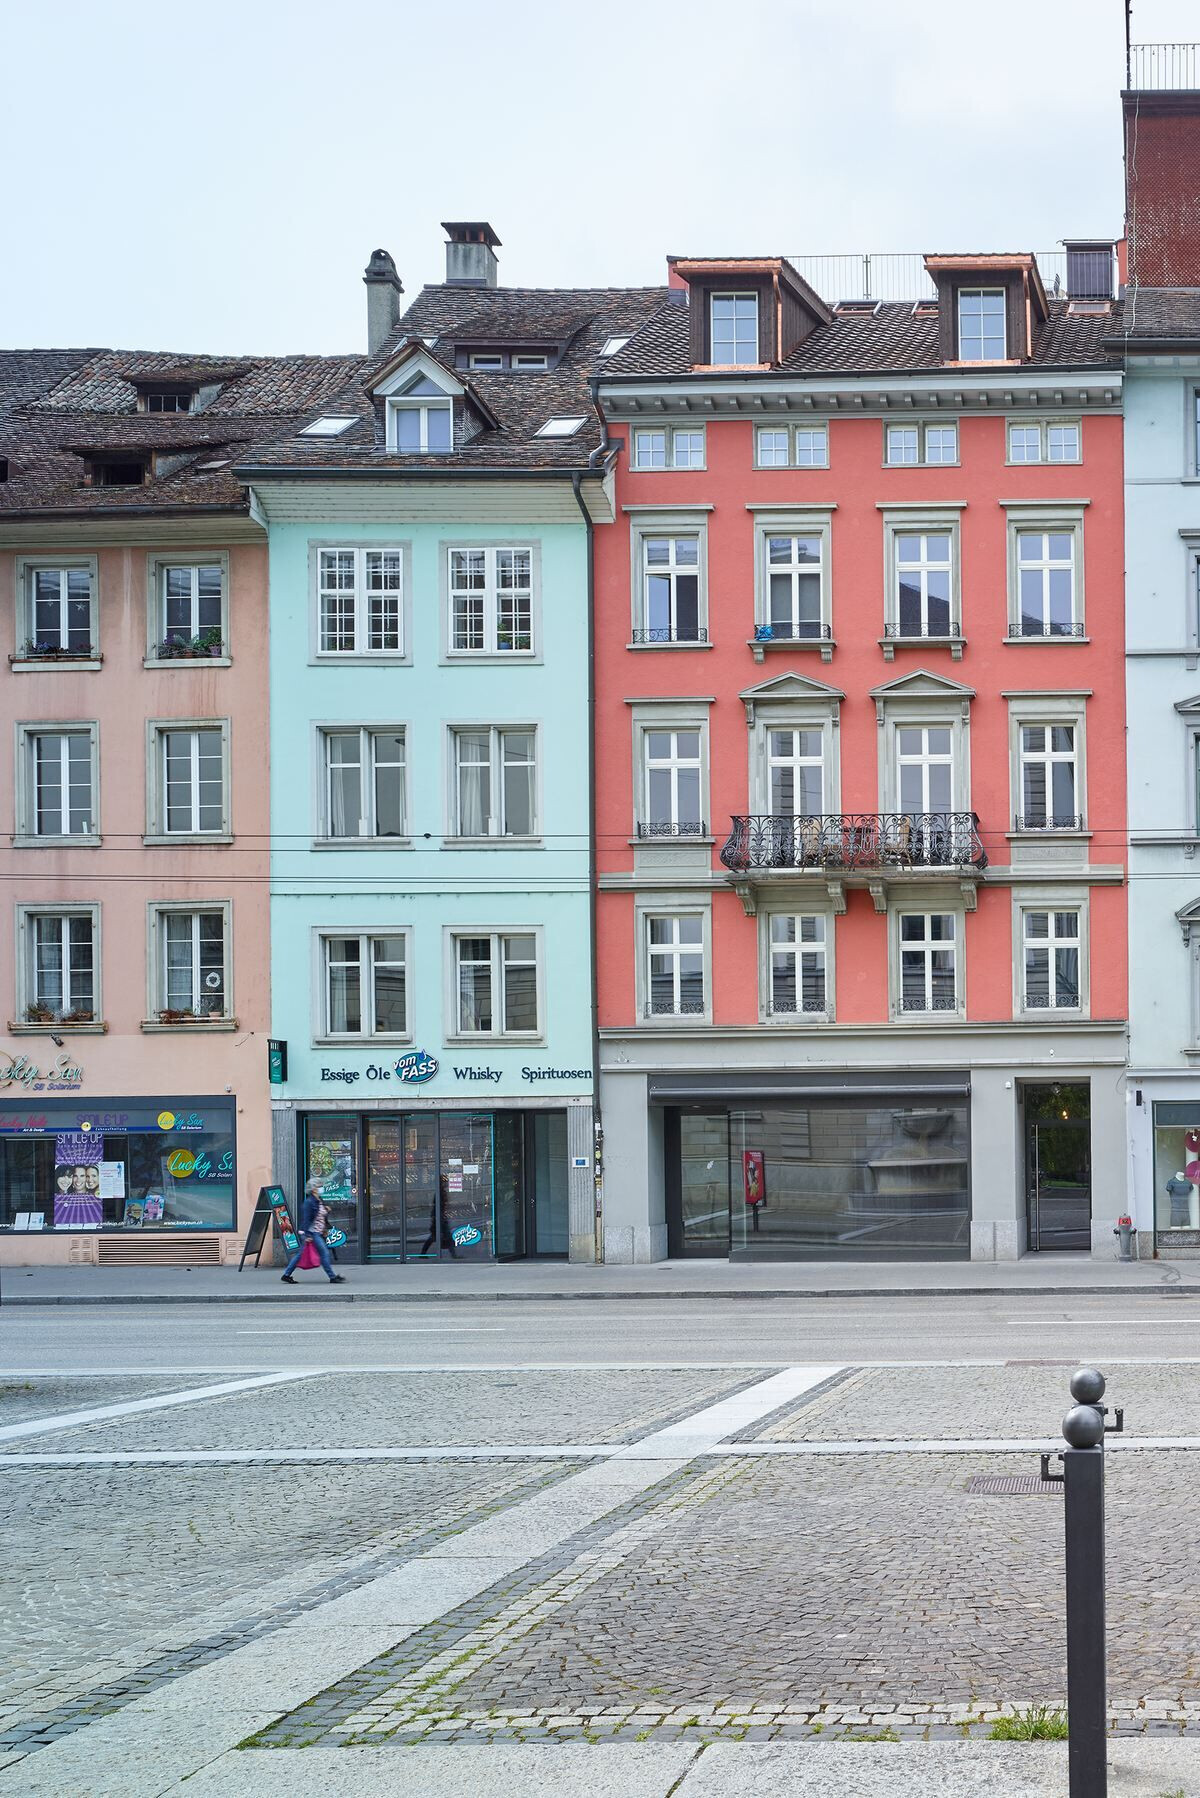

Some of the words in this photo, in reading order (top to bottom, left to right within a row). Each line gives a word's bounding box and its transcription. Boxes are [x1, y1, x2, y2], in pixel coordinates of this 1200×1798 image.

[48, 1053, 83, 1081] Sun
[393, 1055, 416, 1071] vom
[401, 1060, 437, 1081] FASS
[321, 1068, 360, 1083] Essige
[366, 1065, 391, 1080] Öle
[453, 1066, 503, 1083] Whisky
[521, 1066, 592, 1083] Spirituosen
[33, 1083, 45, 1091] SB
[47, 1082, 81, 1091] Solarium
[160, 1113, 184, 1130] Lucky
[186, 1113, 204, 1126] Sun
[170, 1152, 212, 1179] Lucky
[326, 1230, 342, 1245] ASS
[454, 1228, 478, 1247] FASS
